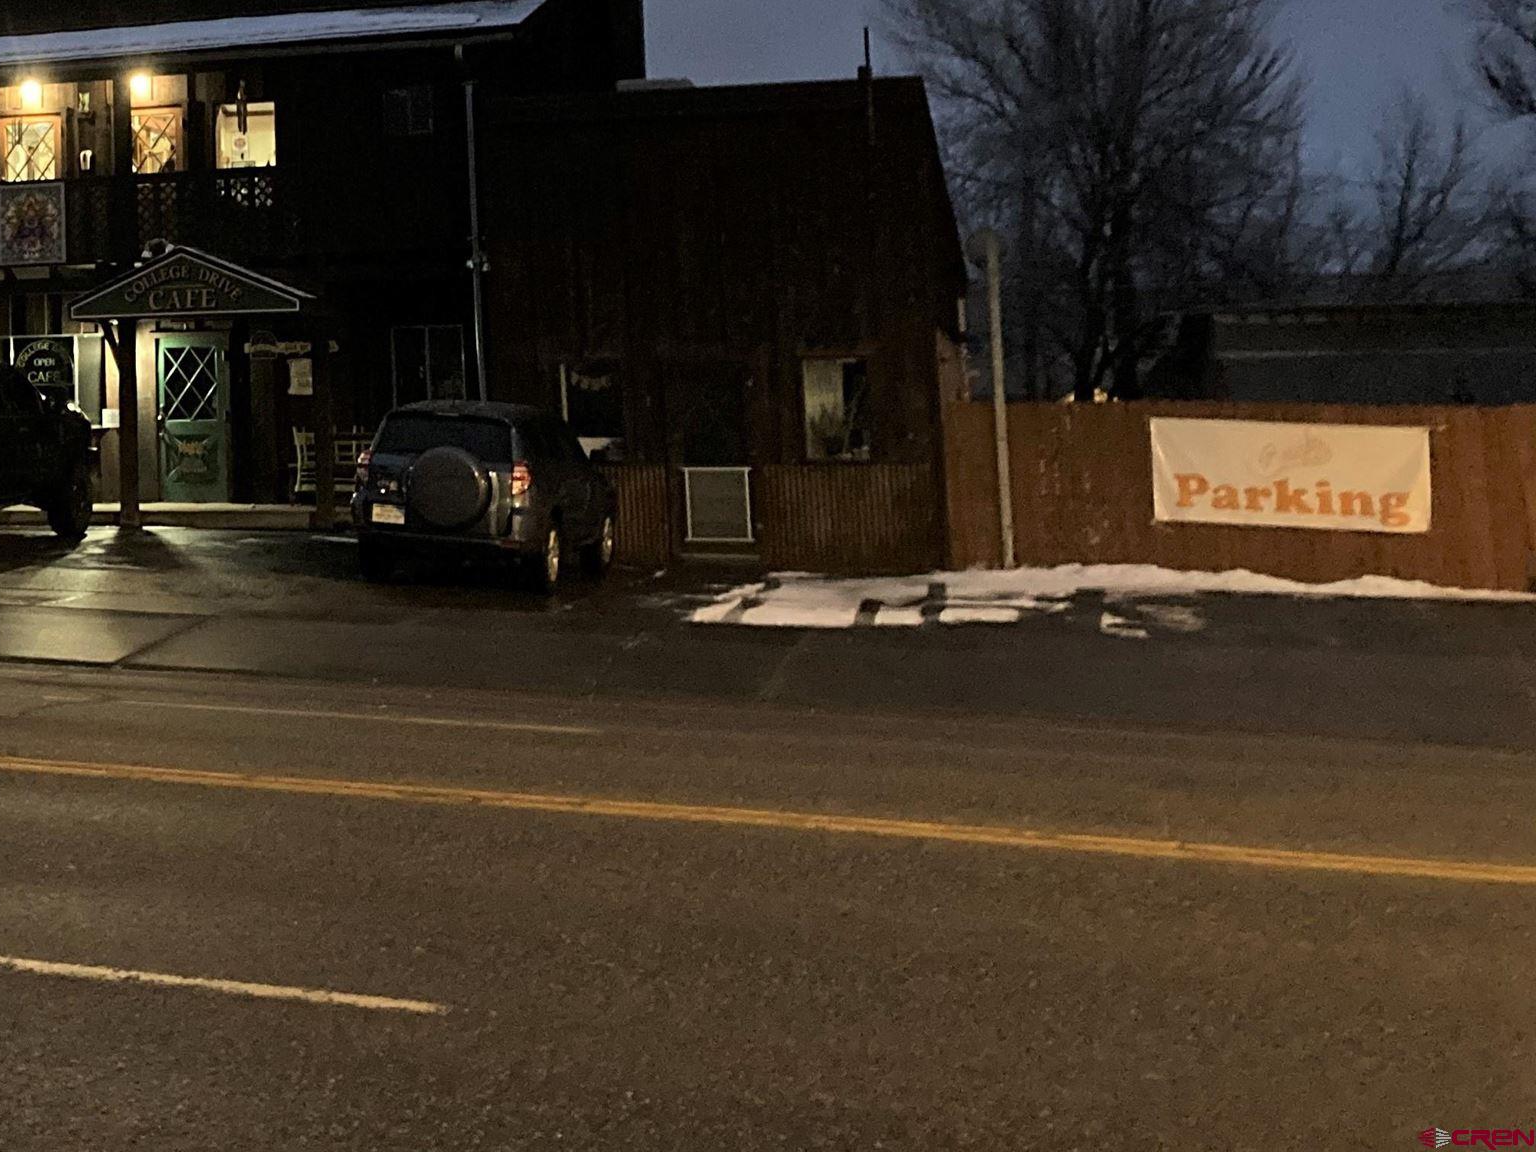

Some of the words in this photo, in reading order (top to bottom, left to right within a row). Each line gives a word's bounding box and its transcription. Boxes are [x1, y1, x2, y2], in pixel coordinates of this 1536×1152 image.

[124, 264, 191, 302] COLLEGE
[199, 268, 242, 301] DRIVE
[148, 288, 217, 310] CAFE
[33, 357, 56, 367] OPEN
[27, 370, 62, 384] CAFE
[1174, 473, 1411, 527] Parking
